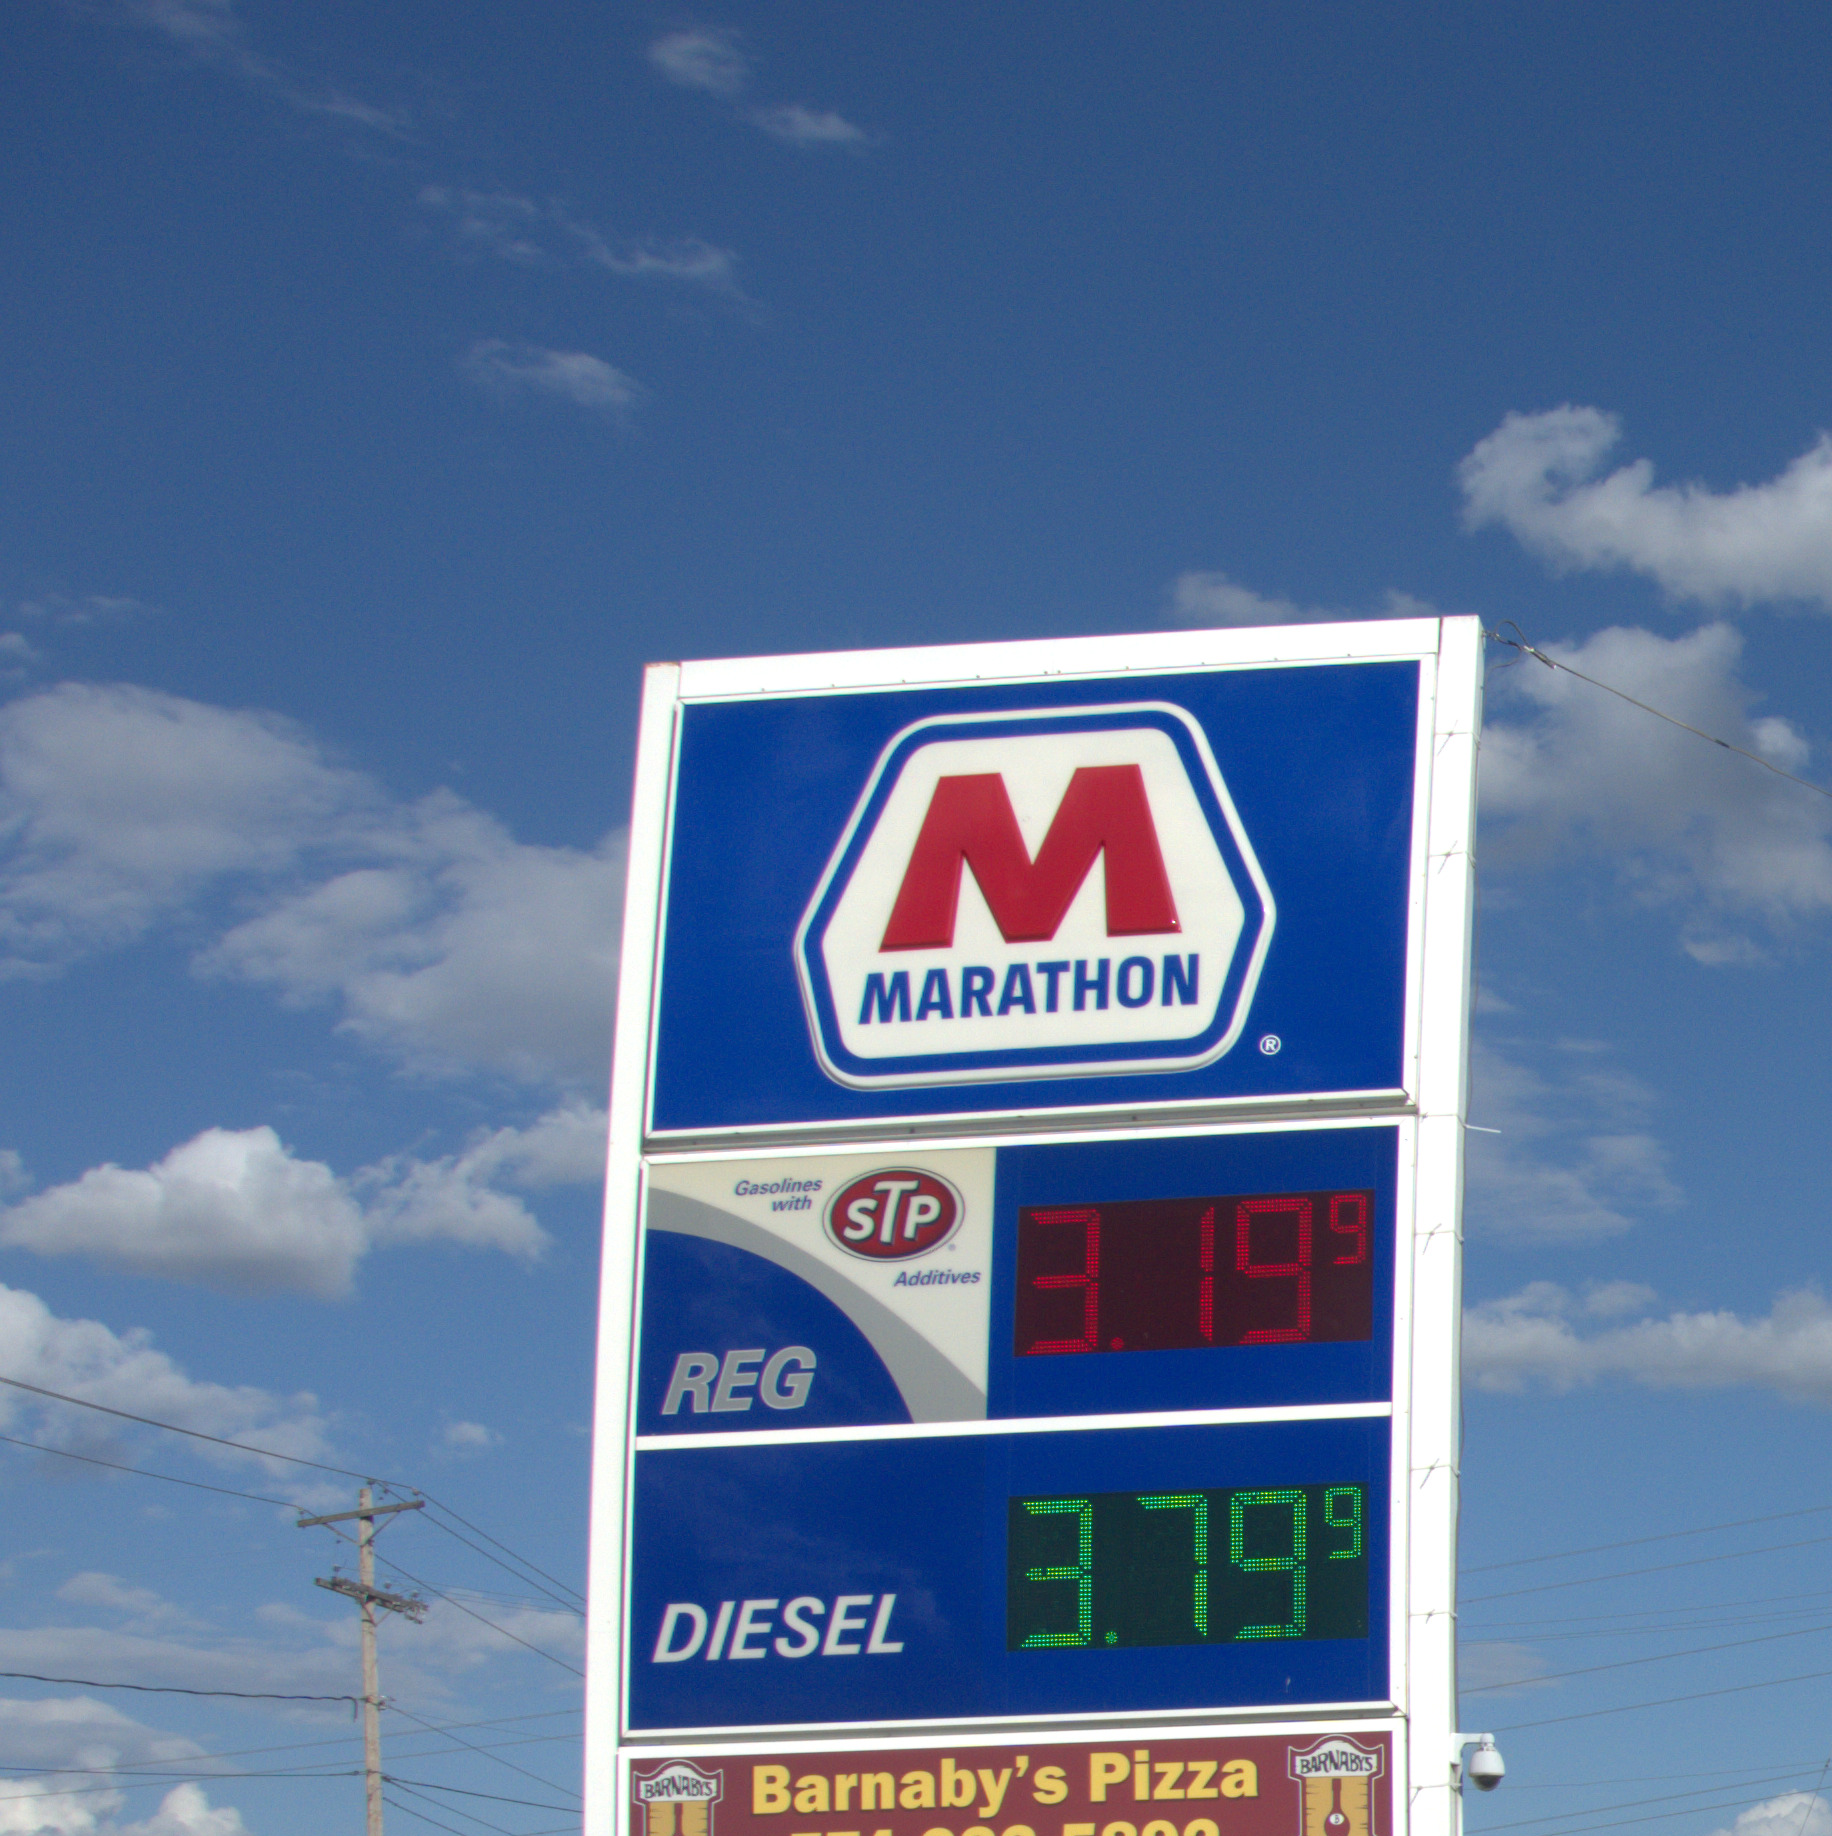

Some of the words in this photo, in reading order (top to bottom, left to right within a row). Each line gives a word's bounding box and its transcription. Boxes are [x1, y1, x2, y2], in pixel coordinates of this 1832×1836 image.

[879, 764, 1181, 952] M
[858, 953, 1199, 1025] MARATHON
[735, 1178, 823, 1196] Gasolines
[772, 1195, 812, 1212] with
[843, 1180, 942, 1246] STP
[894, 1269, 981, 1287] Additives
[661, 1346, 817, 1415] REG
[652, 1594, 905, 1664] DIESEL
[752, 1755, 1069, 1819] Barnaby's
[1091, 1749, 1259, 1803] Pizza
